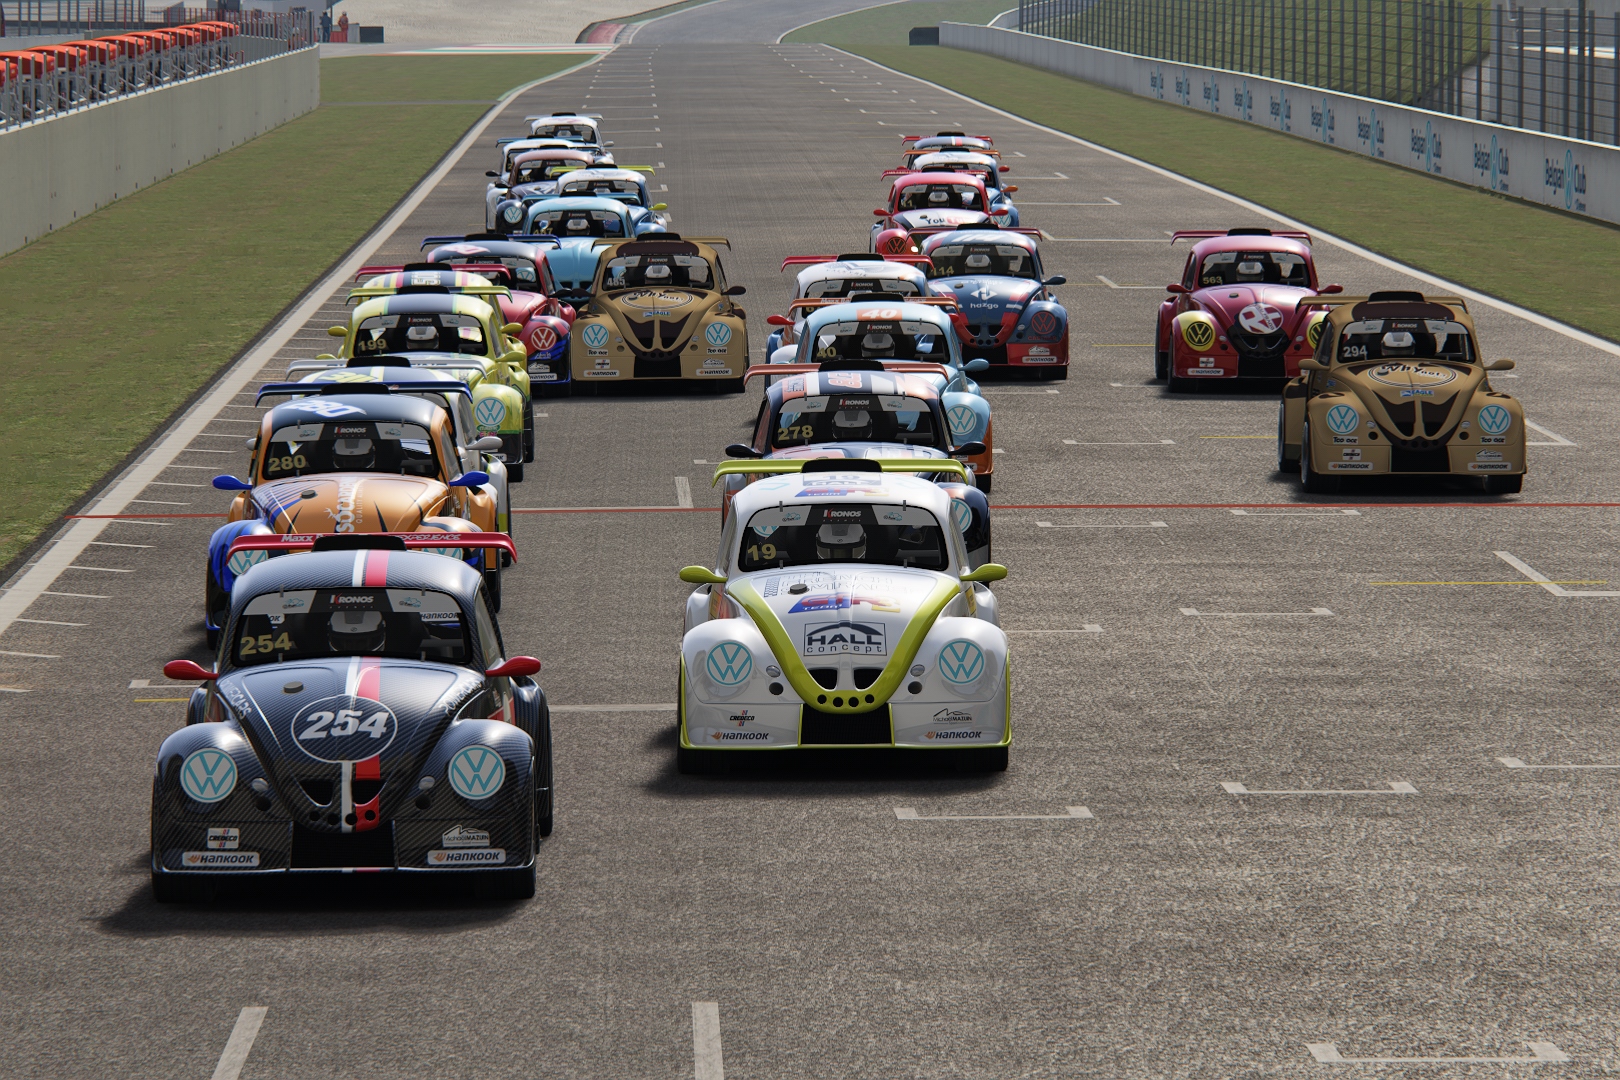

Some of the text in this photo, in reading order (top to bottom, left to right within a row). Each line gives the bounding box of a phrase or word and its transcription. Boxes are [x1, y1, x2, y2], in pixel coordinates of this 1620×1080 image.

[1411, 128, 1441, 160] Belgian Club
[1474, 142, 1509, 177] Belgian Club
[1546, 158, 1586, 195] Belgian Club
[1203, 276, 1222, 285] 563
[862, 309, 898, 319] 40
[358, 338, 387, 351] 199
[817, 346, 836, 358] 40
[1343, 345, 1367, 358] 294
[839, 398, 870, 406] KRONOS
[334, 426, 367, 434] KRONOS
[777, 425, 814, 441] 278
[268, 455, 306, 472] 280
[823, 508, 861, 518] KRONOS
[281, 534, 313, 543] Maxx
[748, 543, 777, 561] 19
[329, 593, 374, 605] KRONOS
[240, 632, 292, 655] 254
[807, 634, 882, 646] HALL
[807, 645, 882, 654] concept
[299, 709, 390, 740] 254
